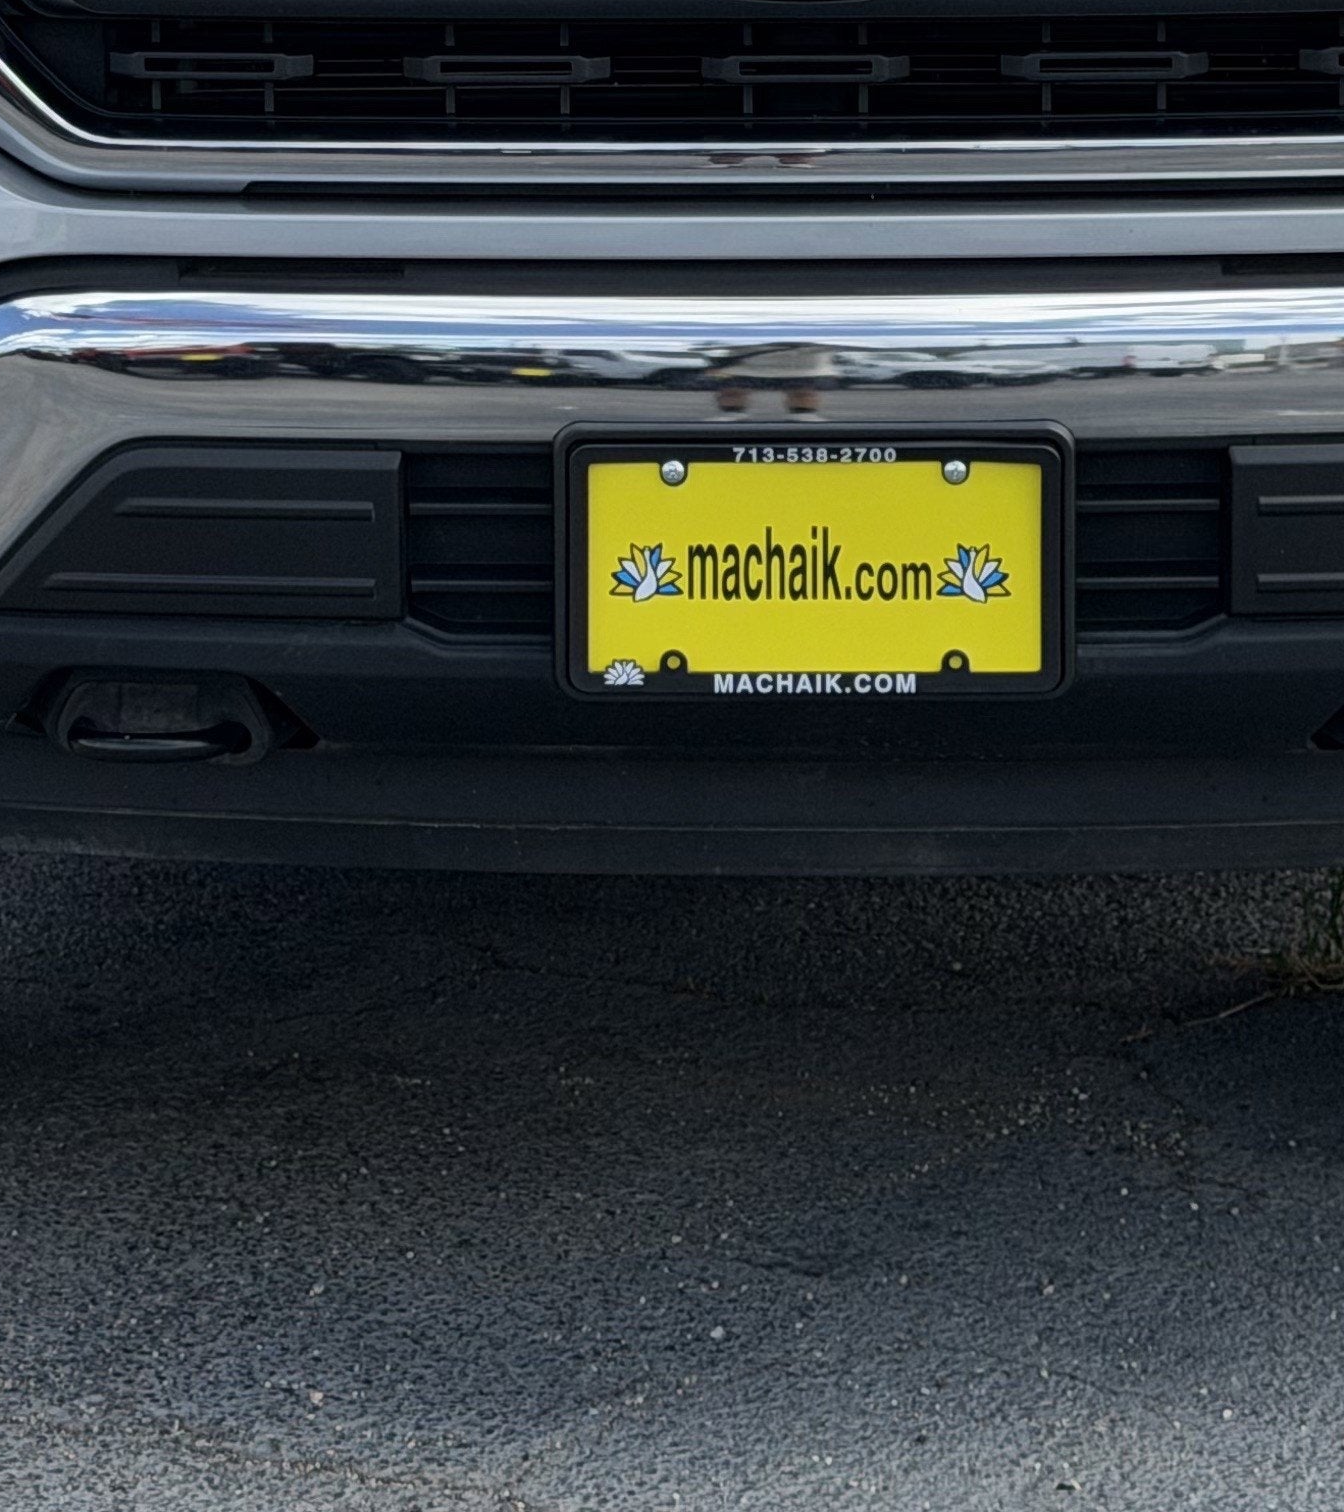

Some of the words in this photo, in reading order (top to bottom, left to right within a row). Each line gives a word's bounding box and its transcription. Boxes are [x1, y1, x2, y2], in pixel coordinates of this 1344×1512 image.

[733, 446, 897, 463] 713-538-2700
[687, 526, 933, 601] machaik.com
[713, 673, 917, 694] MACHAIK.COM
